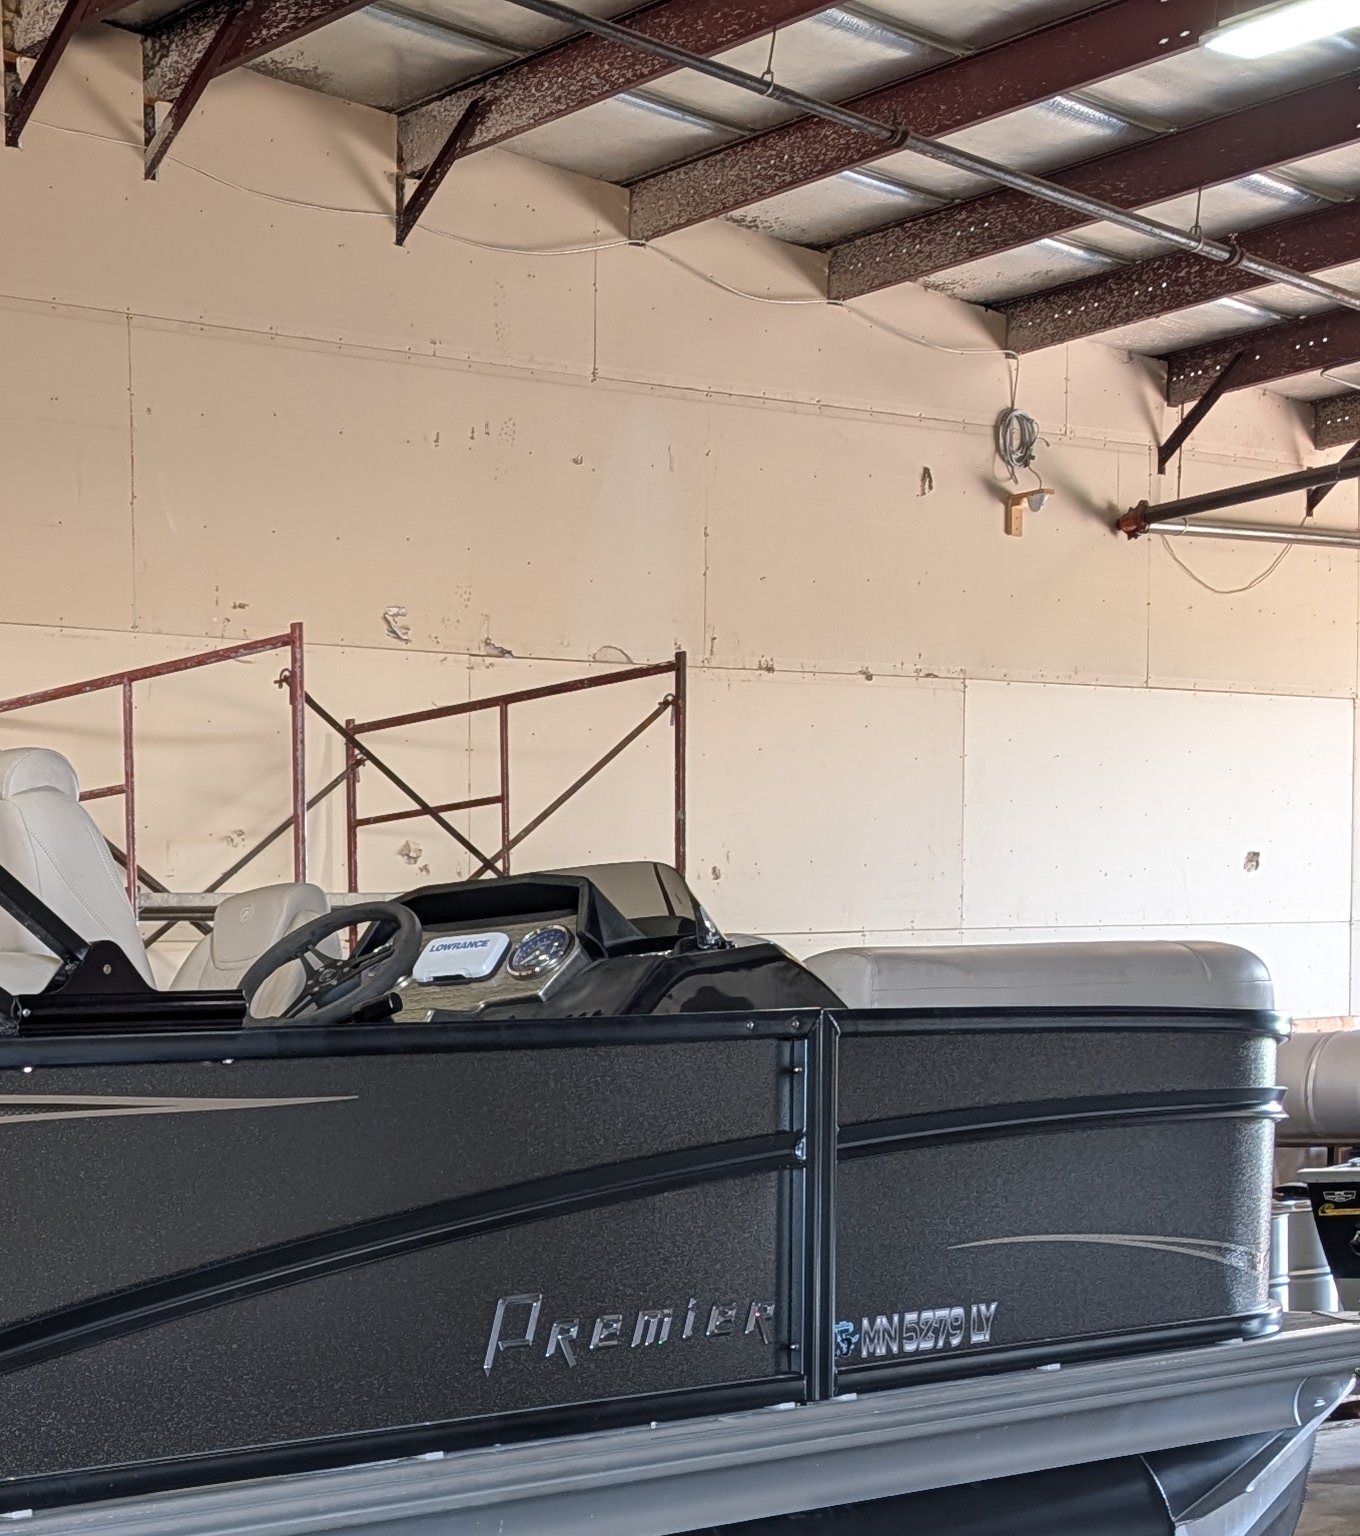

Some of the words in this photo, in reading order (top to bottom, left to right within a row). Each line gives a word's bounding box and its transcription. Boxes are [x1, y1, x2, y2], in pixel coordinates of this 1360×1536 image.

[429, 939, 491, 953] LOWRANCE
[860, 1313, 900, 1359] MN
[902, 1306, 966, 1353] 5279
[969, 1301, 999, 1345] LY
